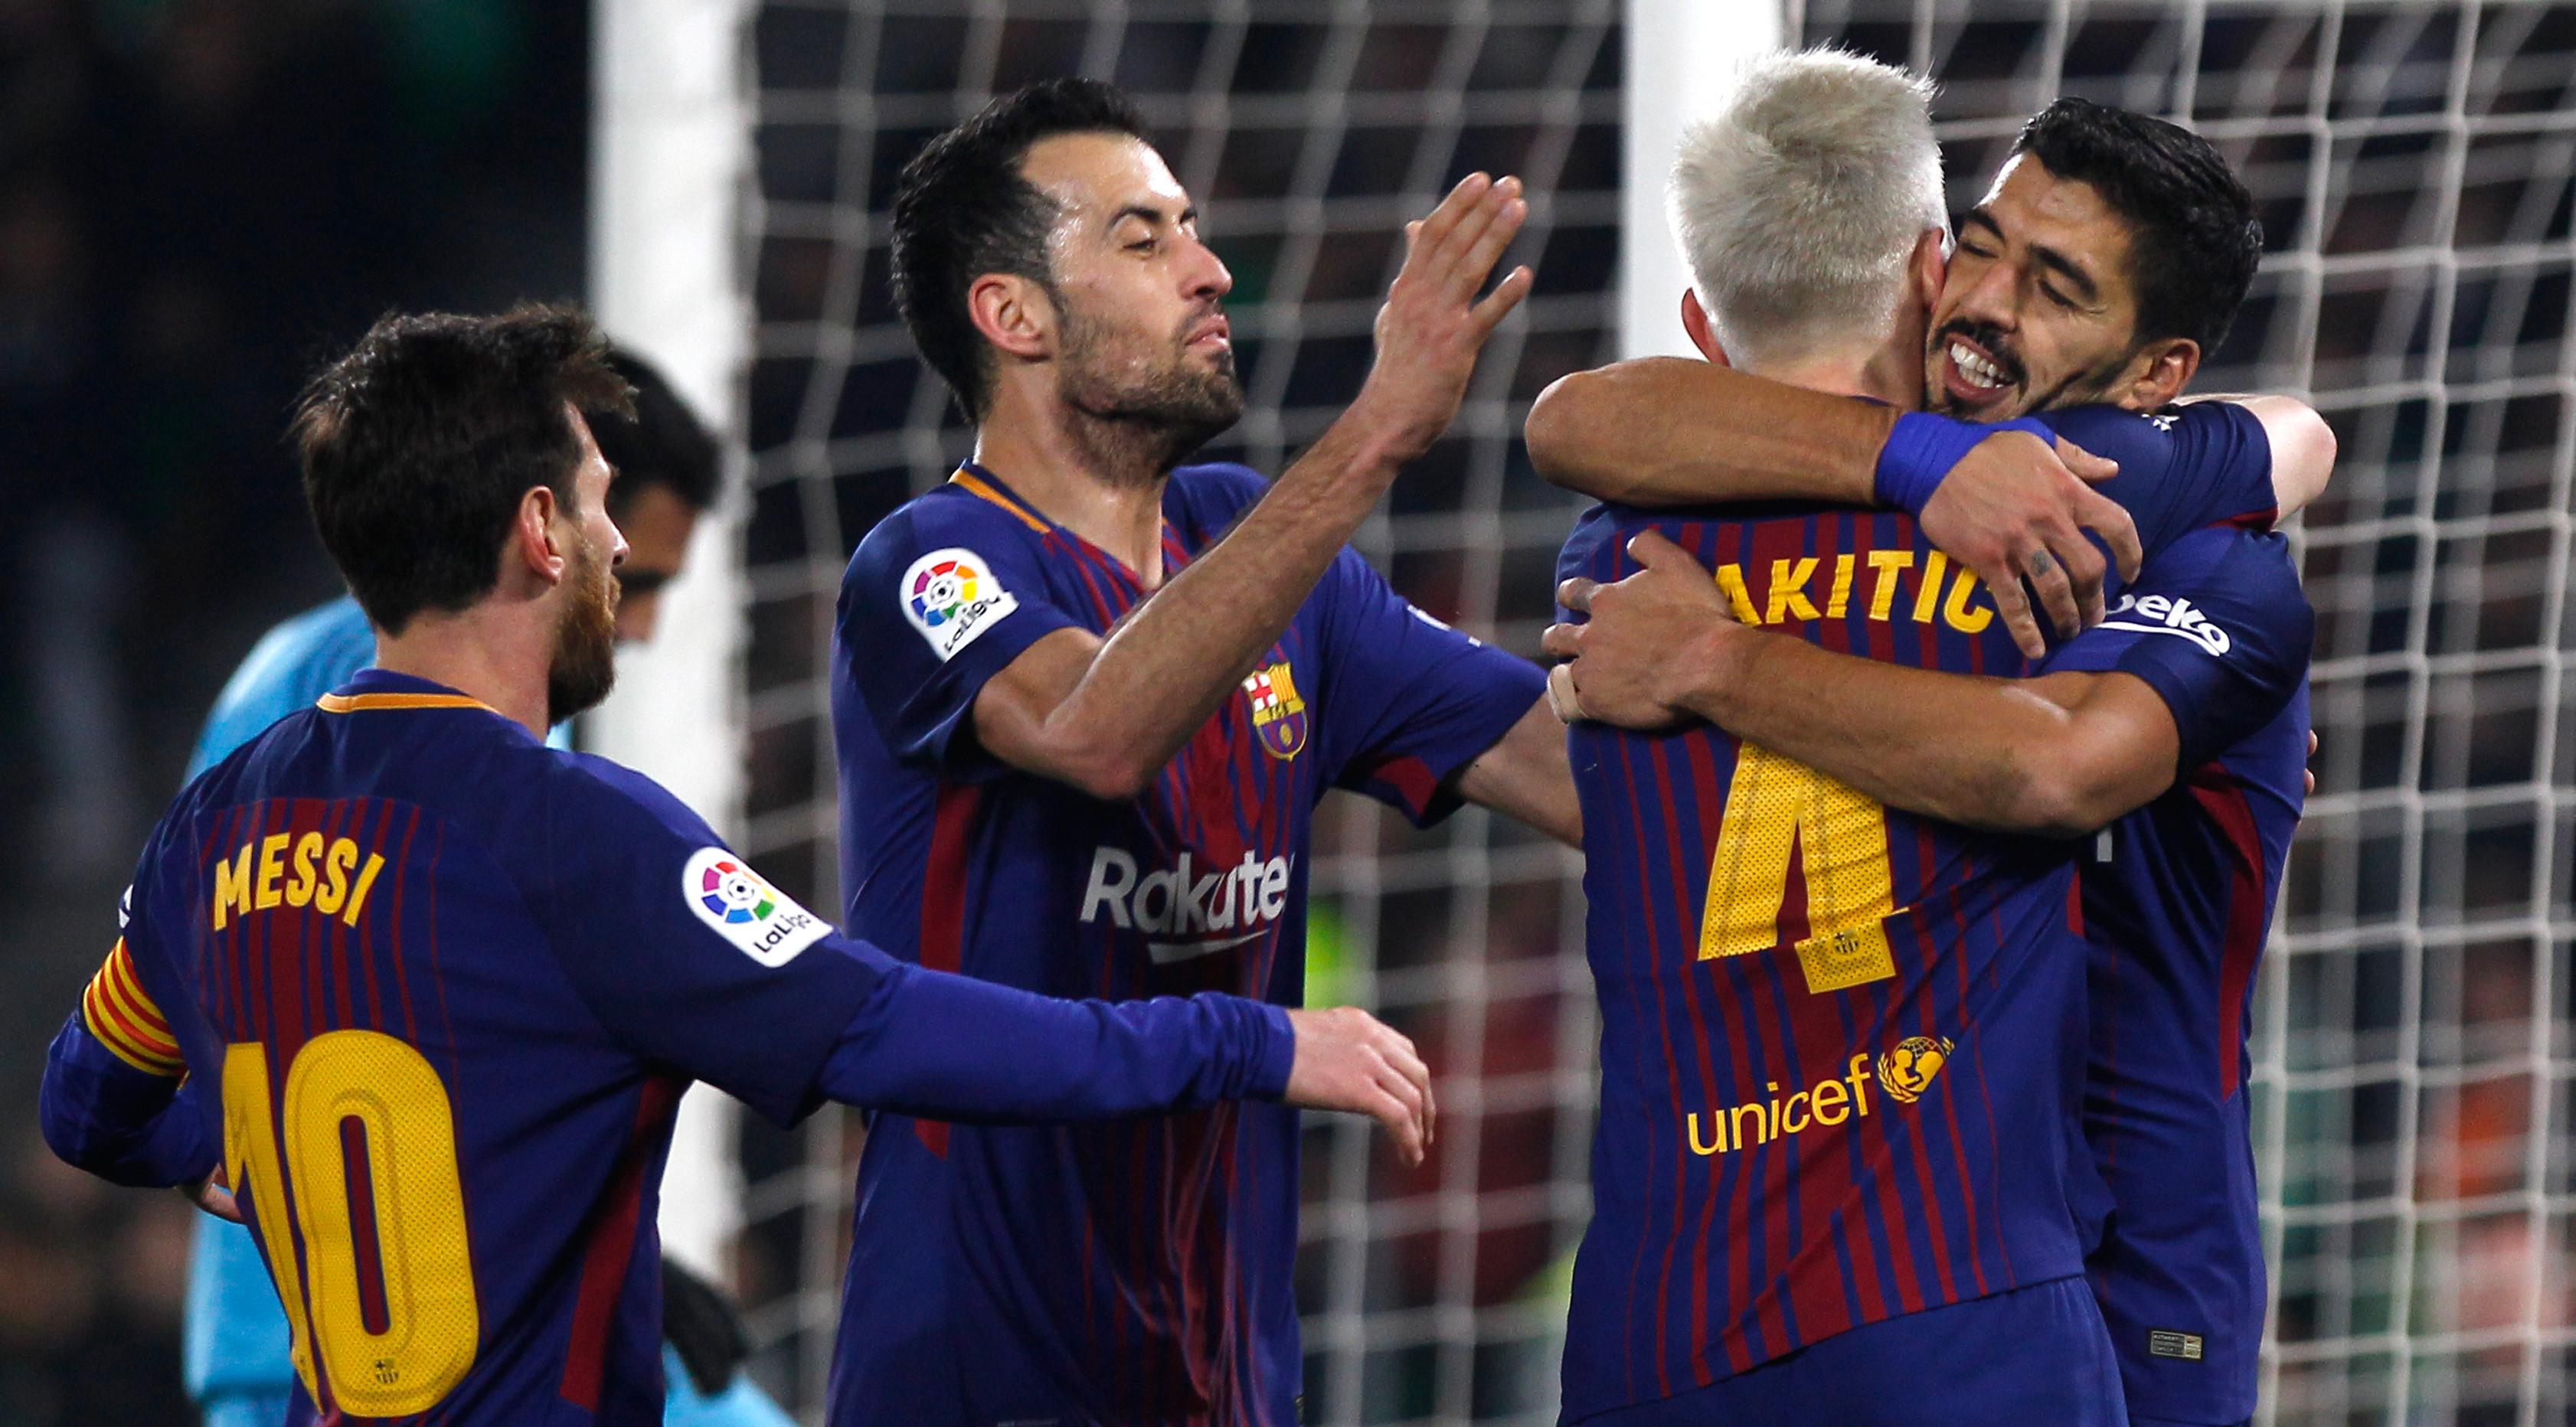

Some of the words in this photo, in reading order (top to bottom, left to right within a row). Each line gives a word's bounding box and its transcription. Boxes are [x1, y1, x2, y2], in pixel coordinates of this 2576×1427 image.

[1715, 550, 1994, 633] AKITIC
[214, 831, 384, 931] MESSI
[1079, 845, 1296, 934] Rakute
[1698, 740, 1909, 994] 4
[1687, 1053, 1872, 1156] unicef
[222, 1029, 479, 1418] 10
